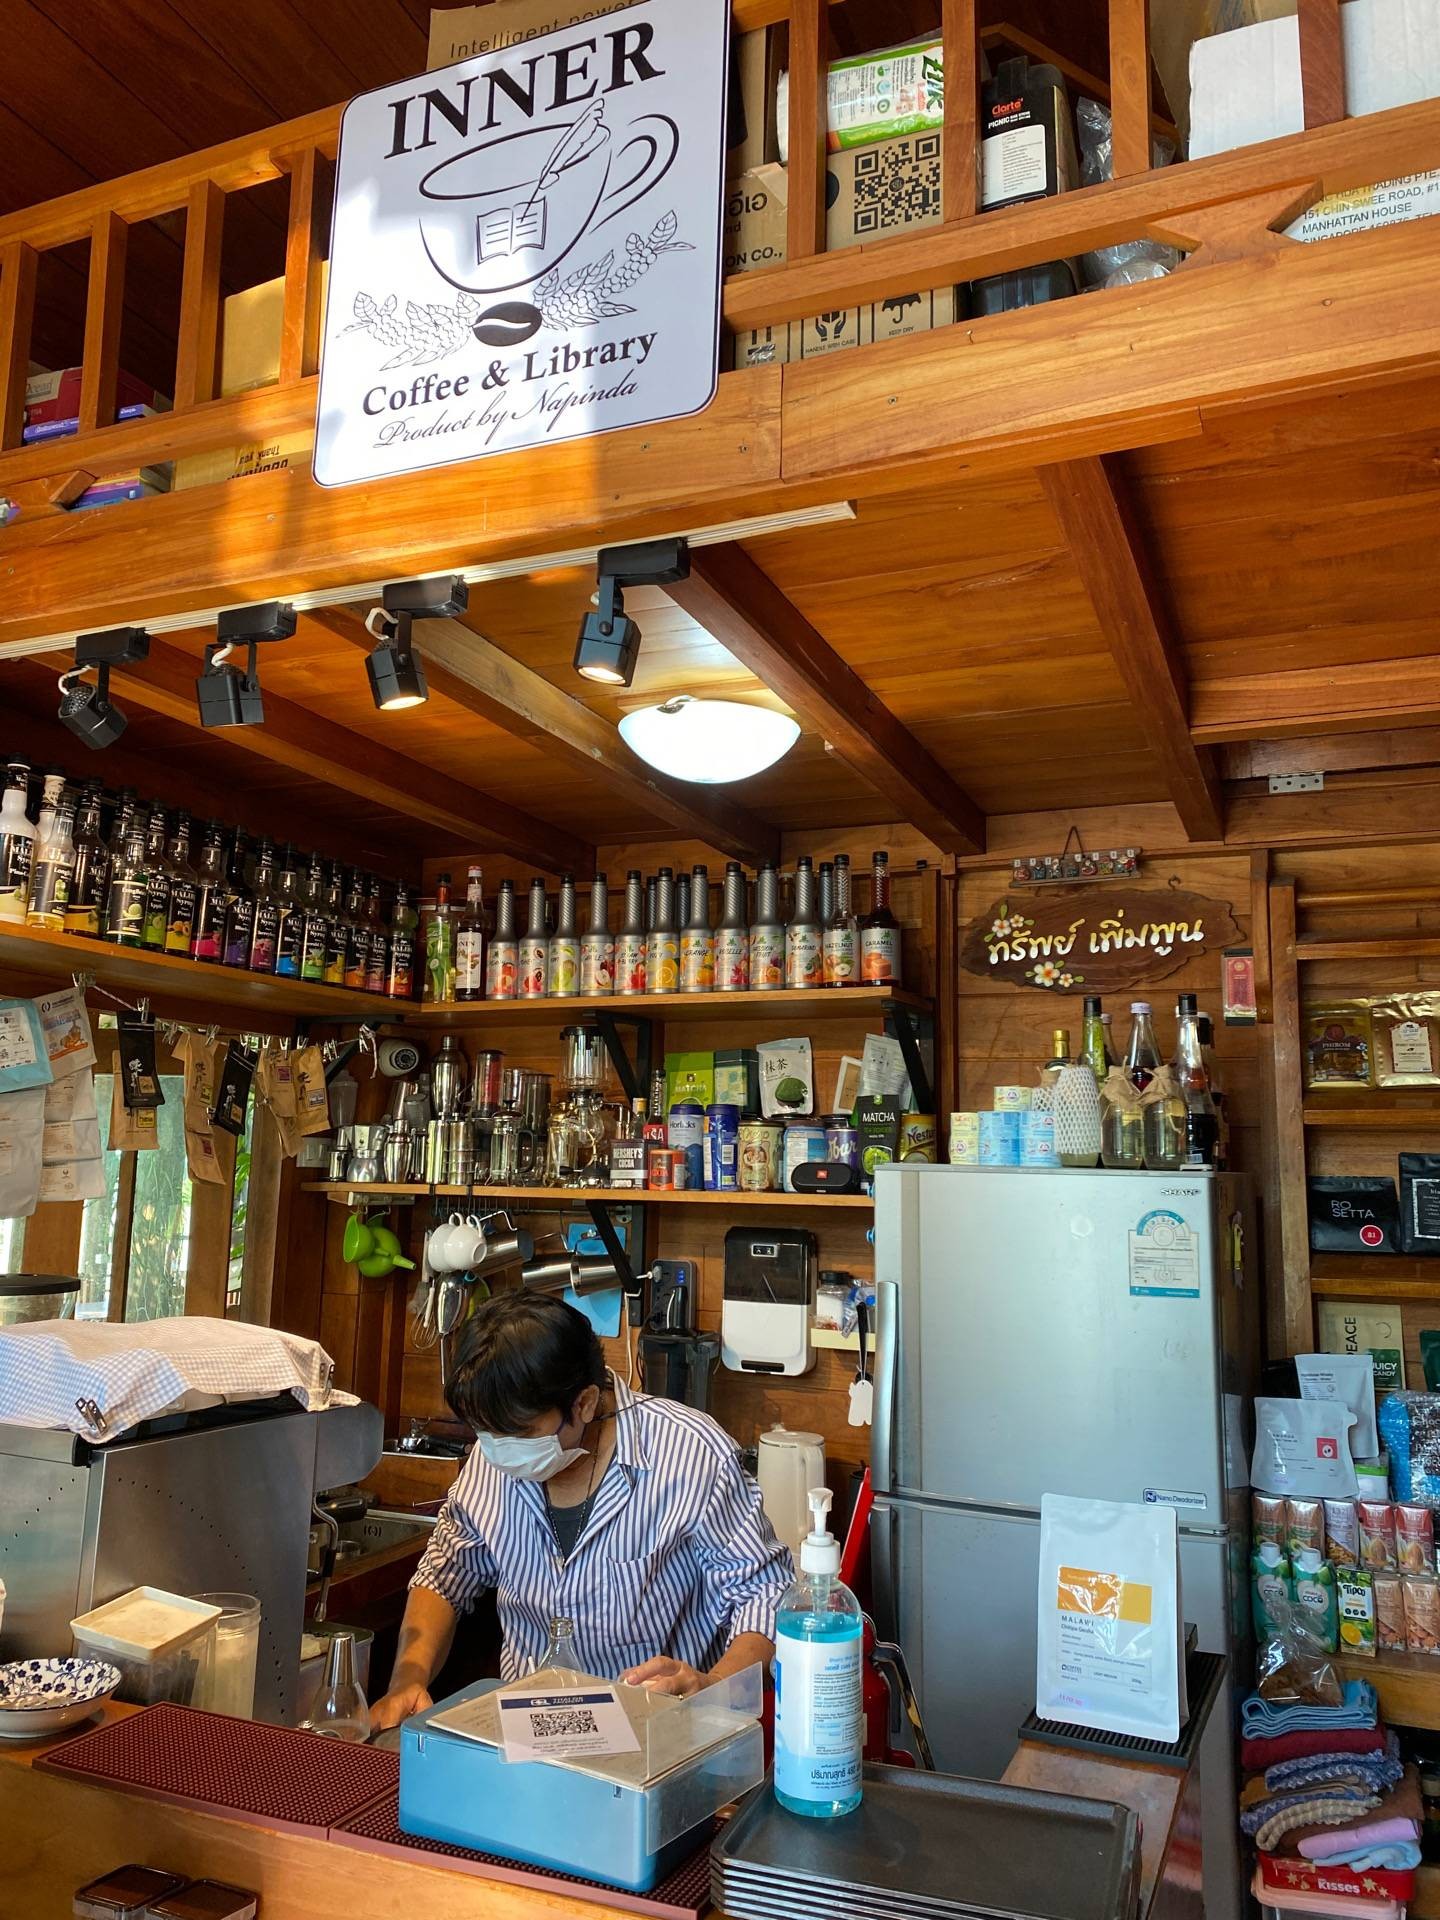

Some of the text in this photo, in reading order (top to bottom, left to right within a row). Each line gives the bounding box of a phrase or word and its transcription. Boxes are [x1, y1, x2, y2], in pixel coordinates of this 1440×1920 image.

[451, 17, 559, 58] Intelligent
[384, 21, 666, 160] INNER
[1322, 201, 1350, 216] CHIN
[1351, 193, 1386, 210] SWEE
[1388, 186, 1424, 201] ROAD,
[1302, 211, 1369, 234] MANHATTAN
[1371, 202, 1413, 220] HOUSE
[751, 246, 782, 262] CO.,
[363, 332, 659, 416] Coffee & Library
[372, 369, 639, 449] Product by Napinda
[989, 908, 1205, 965] ทรัพย์ เพิ่มพูน
[862, 1111, 896, 1123] MATCHA
[613, 1147, 643, 1159] HERSHEY'S
[618, 1158, 635, 1169] COCOA
[1331, 1200, 1352, 1210] RO
[1332, 1209, 1375, 1219] SETTA
[1345, 1316, 1358, 1355] EACE
[1342, 1584, 1366, 1597] Tipco
[1061, 1615, 1094, 1627] MALAWI
[1317, 1878, 1361, 1895] Kisses
